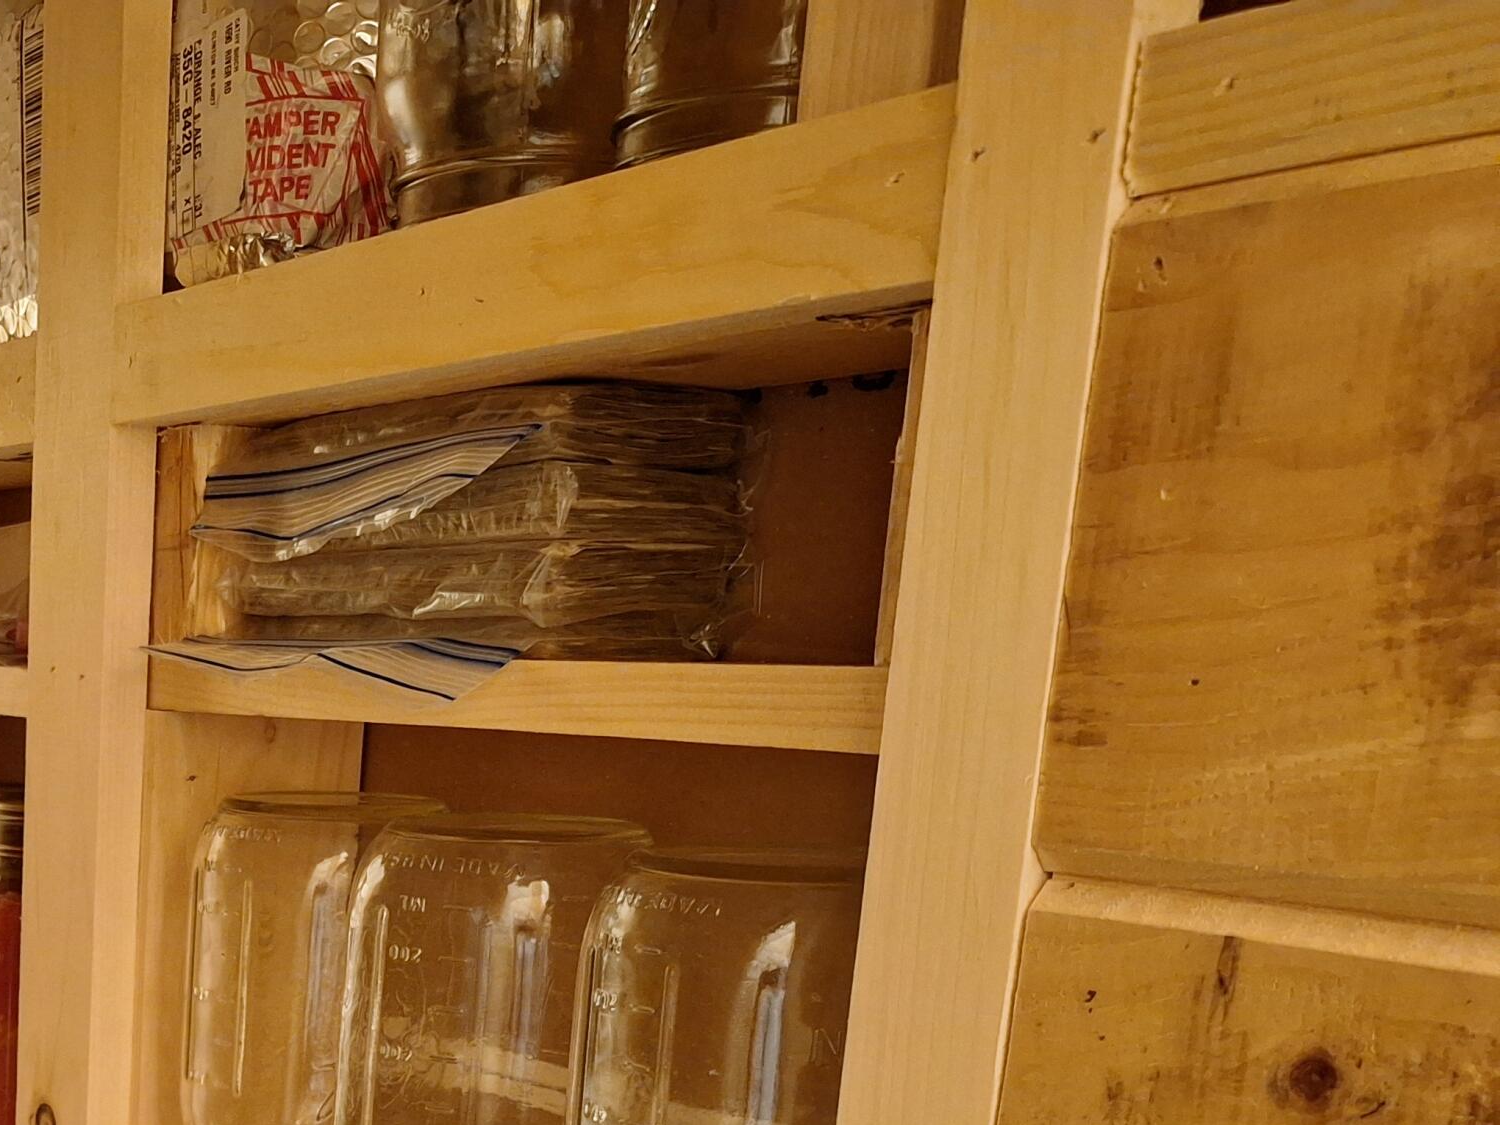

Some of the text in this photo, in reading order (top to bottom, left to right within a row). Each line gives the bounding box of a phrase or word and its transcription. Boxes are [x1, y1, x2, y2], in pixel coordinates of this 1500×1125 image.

[182, 44, 194, 86] 35G
[224, 48, 233, 79] RIVER
[223, 80, 232, 95] RD
[181, 106, 193, 156] 8420
[246, 109, 341, 142] AMPER
[246, 142, 336, 174] VIDENT
[248, 175, 312, 206] TAPE
[388, 944, 422, 963] 200
